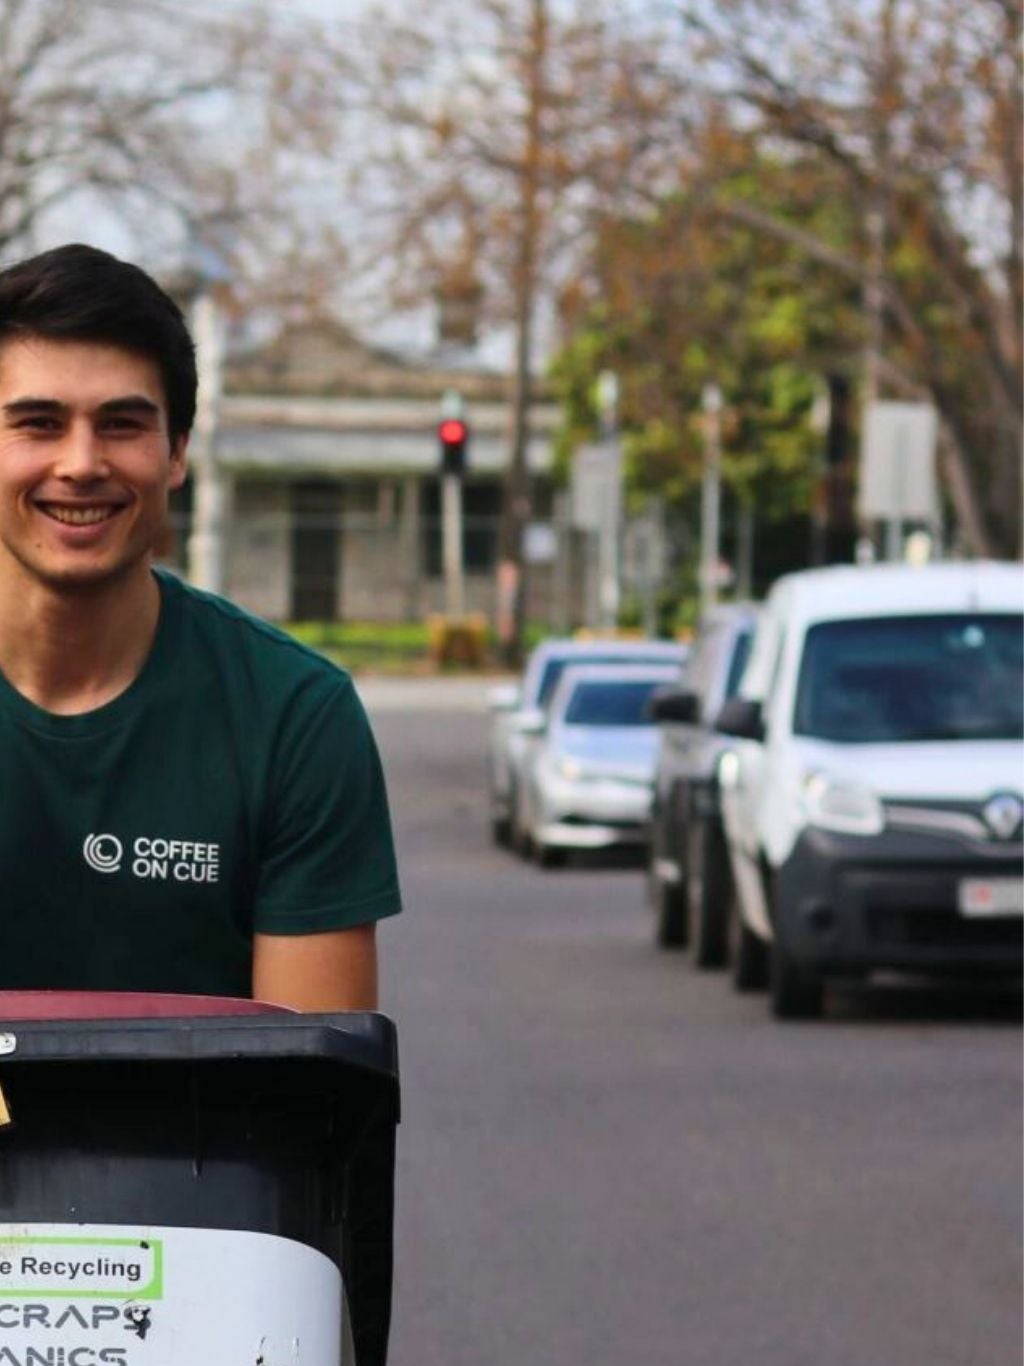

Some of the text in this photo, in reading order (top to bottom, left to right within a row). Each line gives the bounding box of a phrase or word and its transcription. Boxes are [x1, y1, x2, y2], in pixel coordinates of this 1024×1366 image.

[133, 837, 219, 862] COFFEE
[132, 858, 219, 882] ON CUE
[21, 1257, 142, 1281] Recycling
